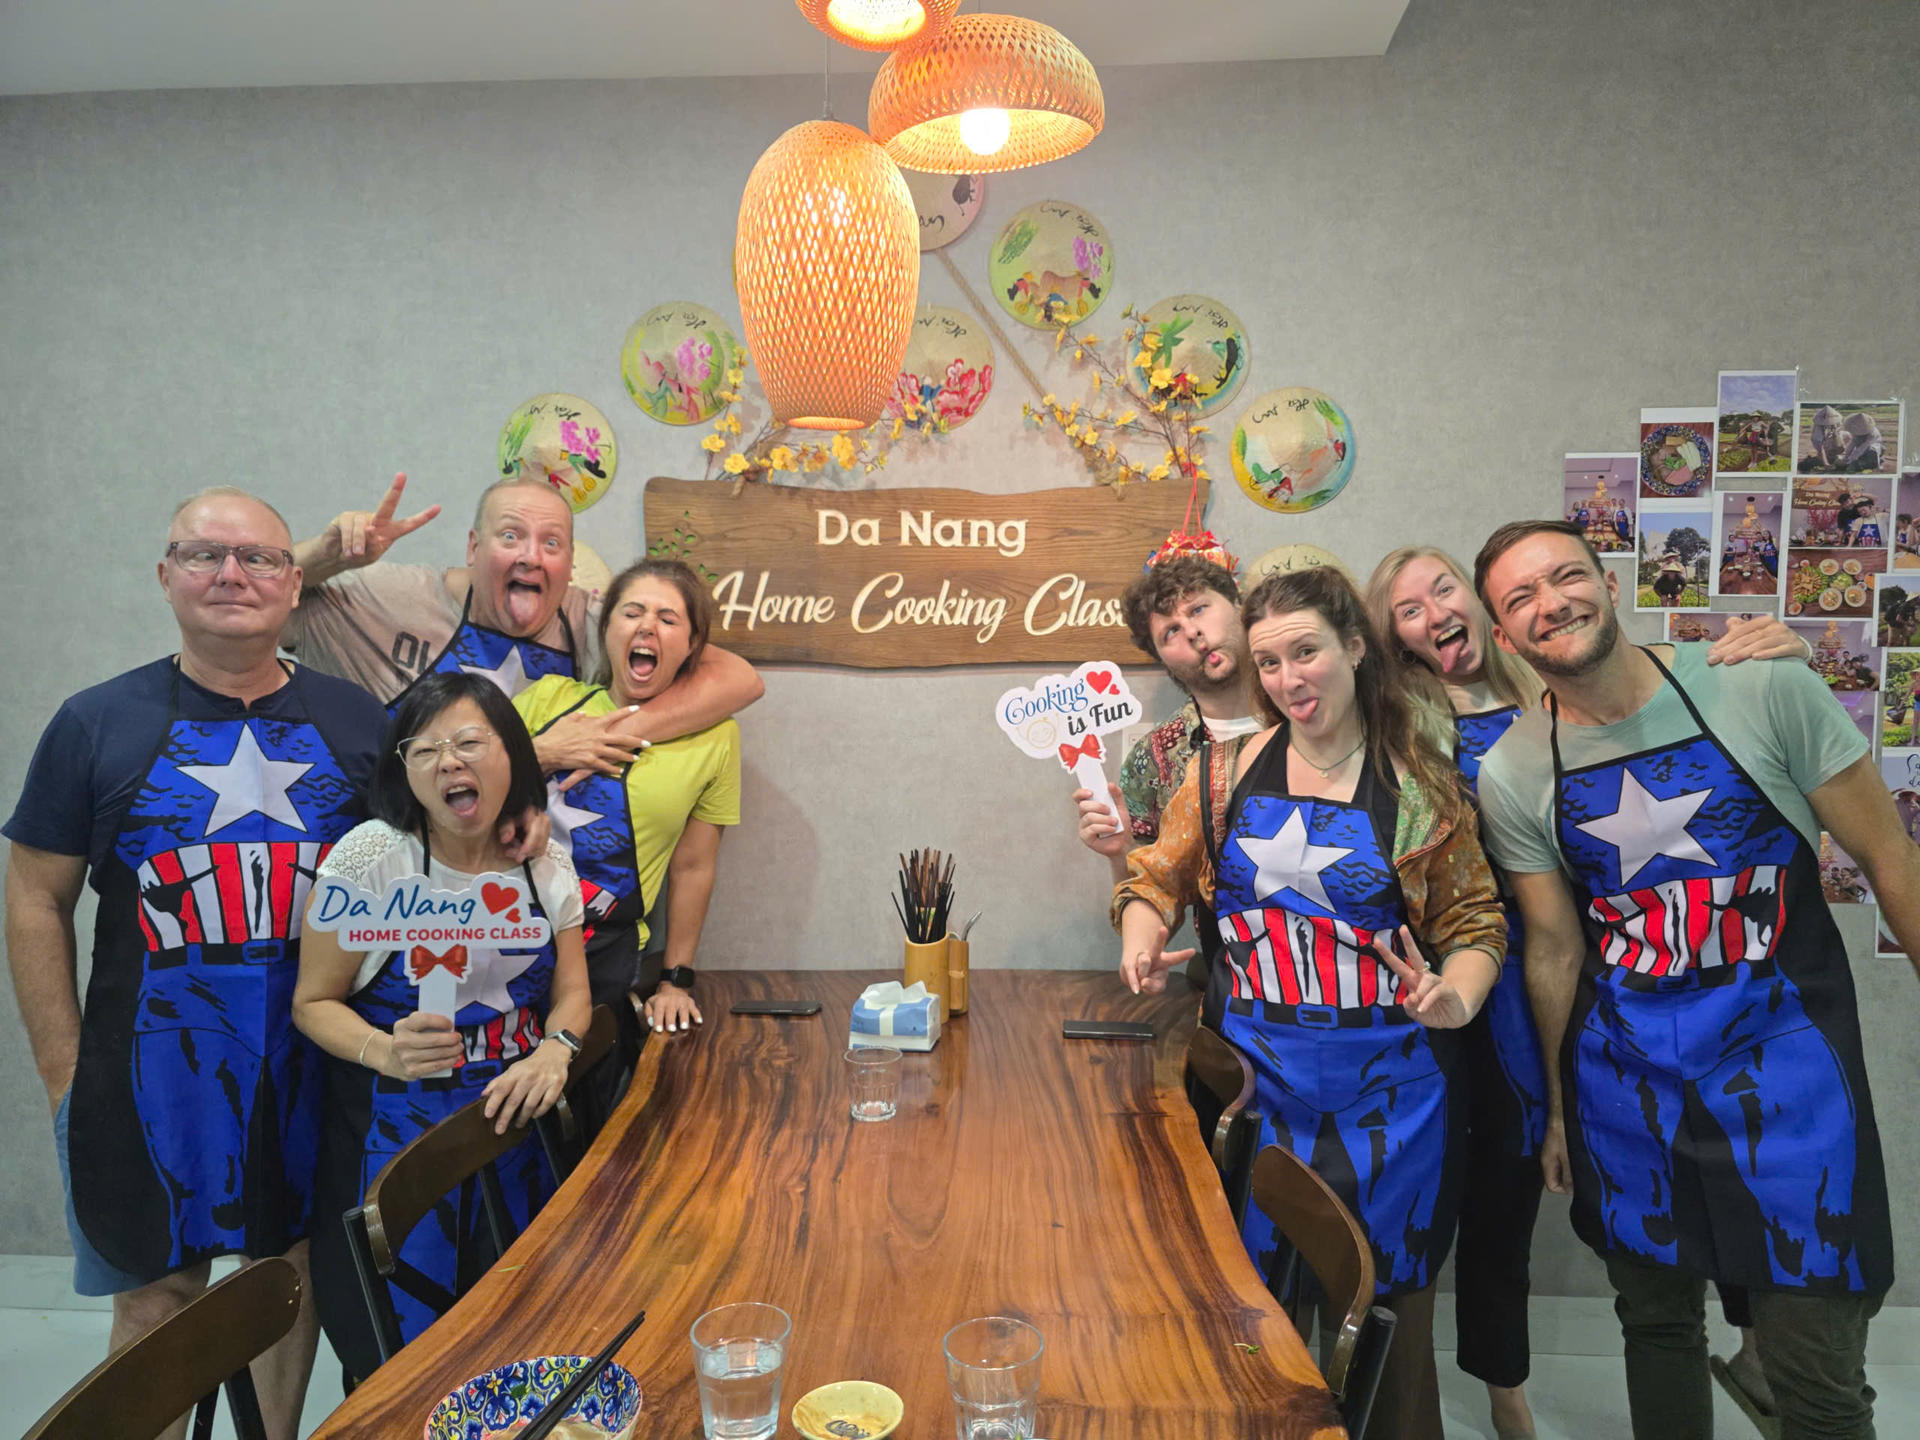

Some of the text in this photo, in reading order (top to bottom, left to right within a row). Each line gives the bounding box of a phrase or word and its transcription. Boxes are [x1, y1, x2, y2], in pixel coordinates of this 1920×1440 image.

[815, 509, 1029, 557] Da Nang
[712, 570, 836, 631] Home
[851, 572, 1007, 643] Cooking
[1005, 678, 1089, 725] Cooking
[1067, 702, 1133, 736] is Fun
[318, 884, 476, 925] Da Nang
[349, 927, 542, 942] HOME COOKING CLASS
